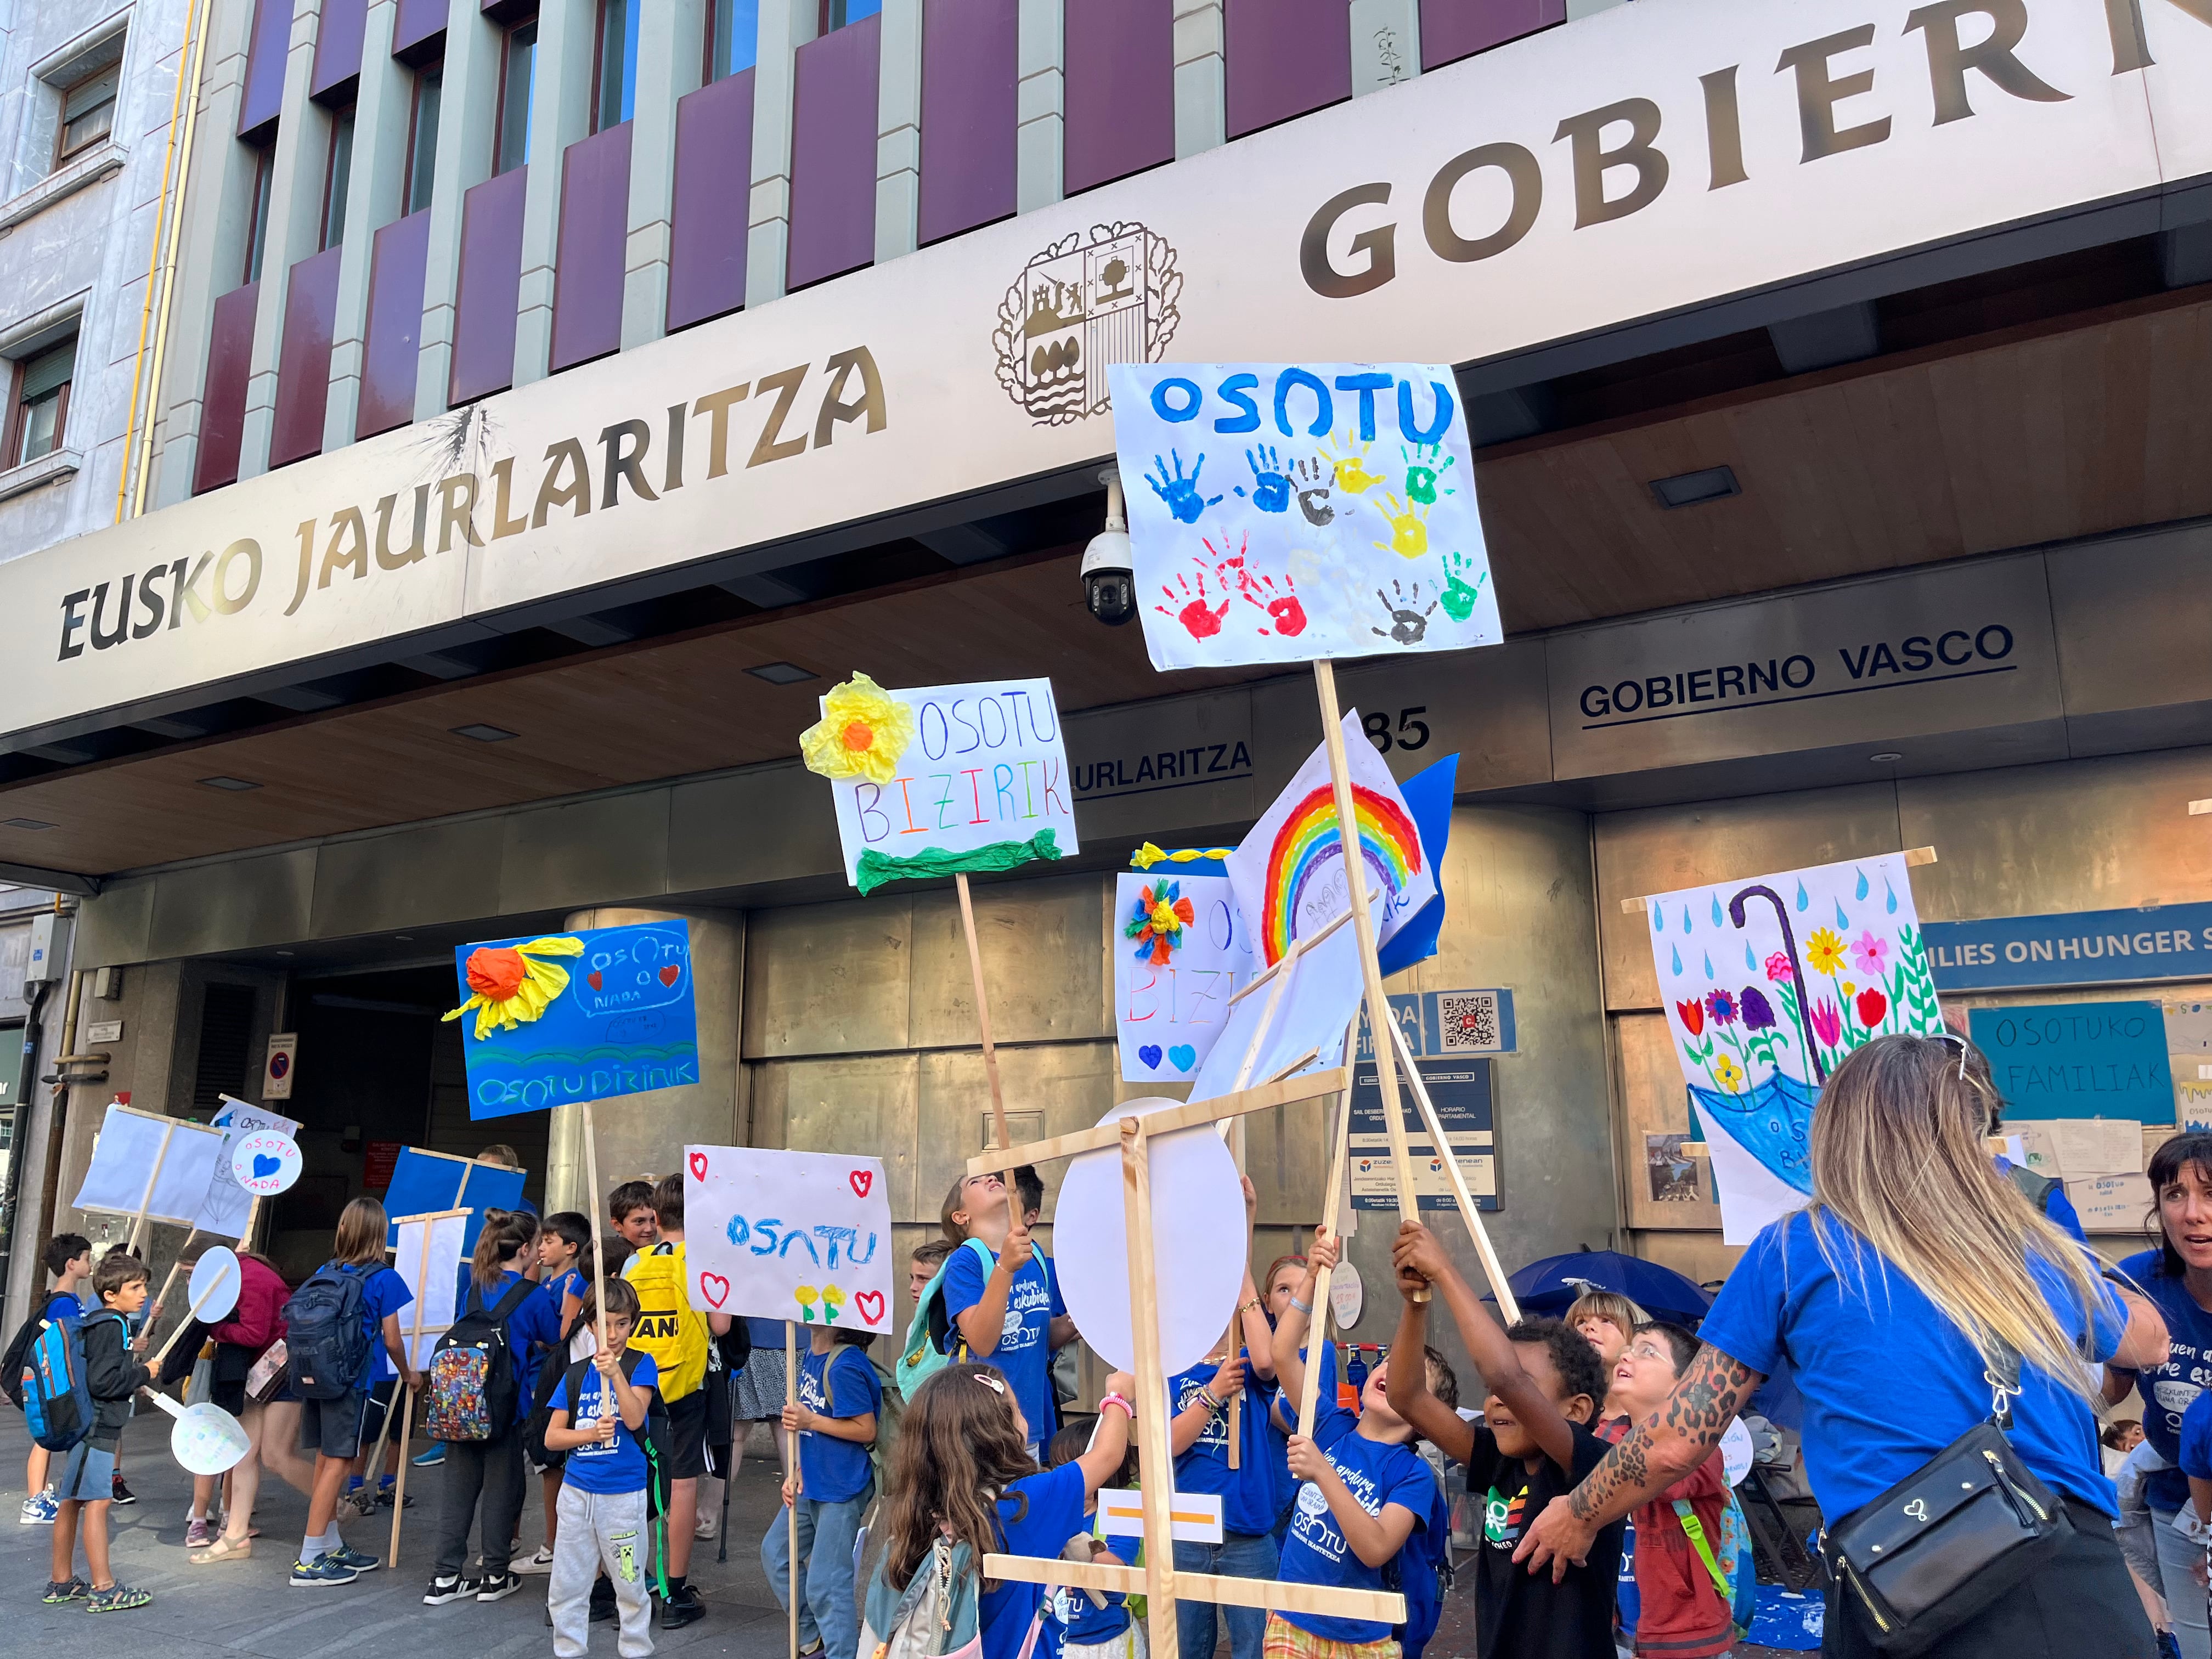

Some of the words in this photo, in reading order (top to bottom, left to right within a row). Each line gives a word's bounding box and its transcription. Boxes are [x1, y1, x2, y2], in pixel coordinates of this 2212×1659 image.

[1300, 0, 2212, 298] GOBIER
[1150, 368, 1454, 445] OSOTU
[57, 538, 263, 662] EUSKO
[284, 345, 887, 617] JAURLARITZA
[1581, 654, 1815, 718] GOBIERNO
[1839, 624, 2014, 680] VASCO
[921, 690, 1056, 760] OSOTU
[1073, 741, 1252, 791] URLARITZA
[854, 757, 1070, 843] BIZIRIK
[591, 936, 687, 970] OSOTU
[2005, 940, 2053, 963] ON
[2059, 929, 2194, 961] HUNGER
[1124, 967, 1259, 1023] BIZI
[1996, 1016, 2146, 1047] OSOTUKO
[2007, 1062, 2165, 1093] FAMILIAK
[246, 1137, 296, 1157] OSOTU
[240, 1175, 280, 1189] NADA
[726, 1214, 877, 1271] OSOTU
[2168, 1342, 2196, 1359] uen
[1294, 1511, 1347, 1555] OSOTU
